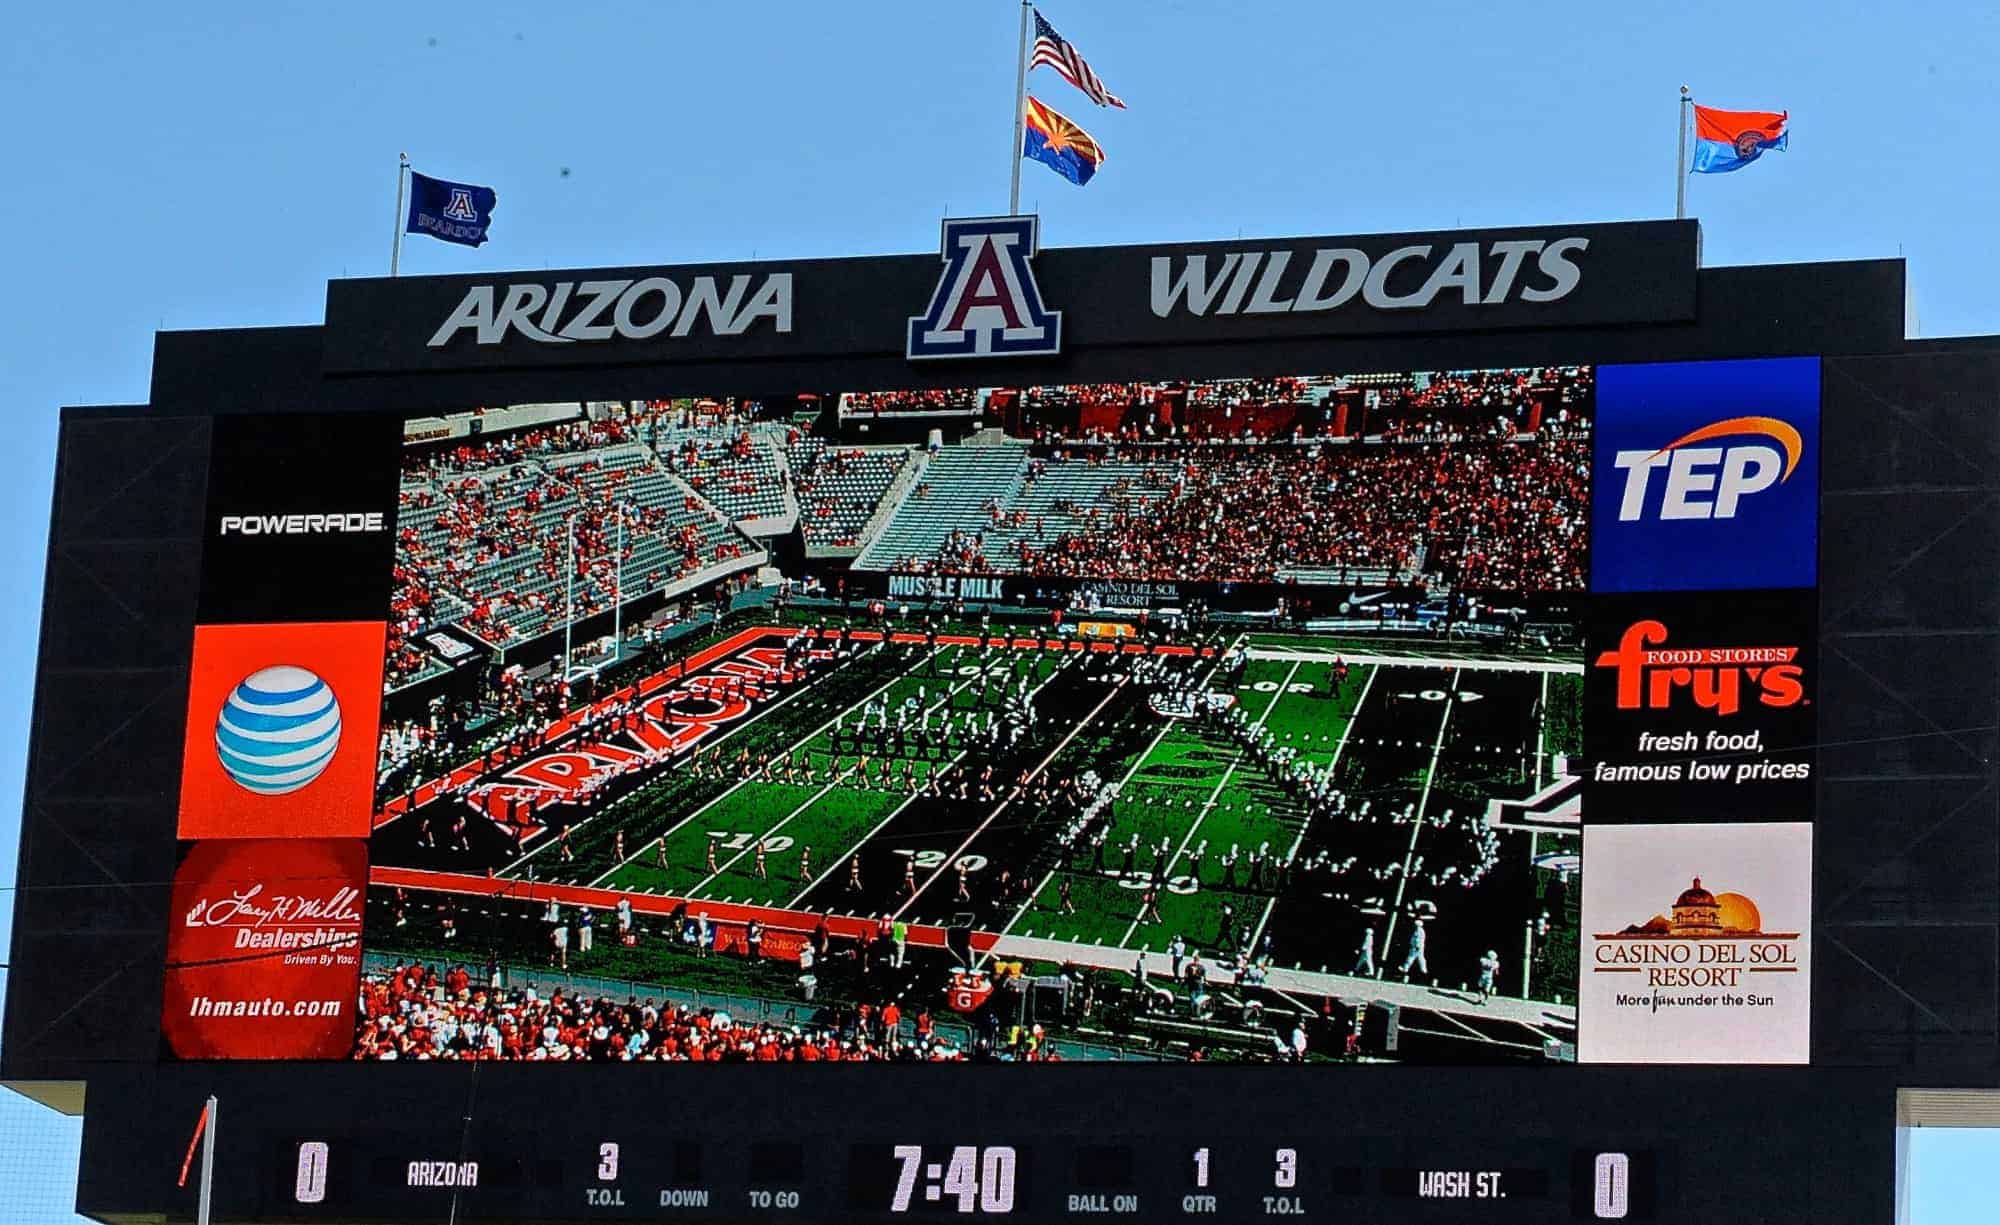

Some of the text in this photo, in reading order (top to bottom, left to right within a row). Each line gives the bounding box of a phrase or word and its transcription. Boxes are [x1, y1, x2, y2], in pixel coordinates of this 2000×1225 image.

[426, 237, 1590, 348] ARIZONA WILDCATS
[906, 215, 1062, 360] A
[1614, 446, 1782, 521] TEP
[220, 512, 384, 535] POWERADE
[960, 577, 1004, 598] MILK
[1595, 620, 1803, 716] fry's
[1647, 648, 1788, 664] FOOD STORES
[1638, 729, 1764, 752] fresh food,
[1594, 760, 1810, 784] famous low prices
[235, 927, 359, 952] Dealerships
[284, 954, 357, 966] Driven By You.
[1595, 943, 1797, 964] CASINO DEL SOL
[1648, 967, 1742, 987] RESORT
[190, 996, 341, 1016] lhmauto.com
[1616, 994, 1650, 1006] More
[1678, 994, 1719, 1006] under
[1722, 994, 1744, 1006] the
[1747, 994, 1774, 1006] Sun
[296, 1142, 328, 1202] 0
[598, 1142, 619, 1180] 3
[1193, 1147, 1209, 1187] 1
[1274, 1148, 1297, 1188] 3
[407, 1161, 479, 1187] ARIZONA
[891, 1145, 1016, 1213] 7:40
[1418, 1171, 1506, 1198] WASH ST.
[1594, 1152, 1629, 1218] 0
[660, 1190, 709, 1207] DOWN
[749, 1191, 800, 1208] TO GO
[1068, 1194, 1137, 1213] BALL ON
[1182, 1195, 1216, 1214] QTR
